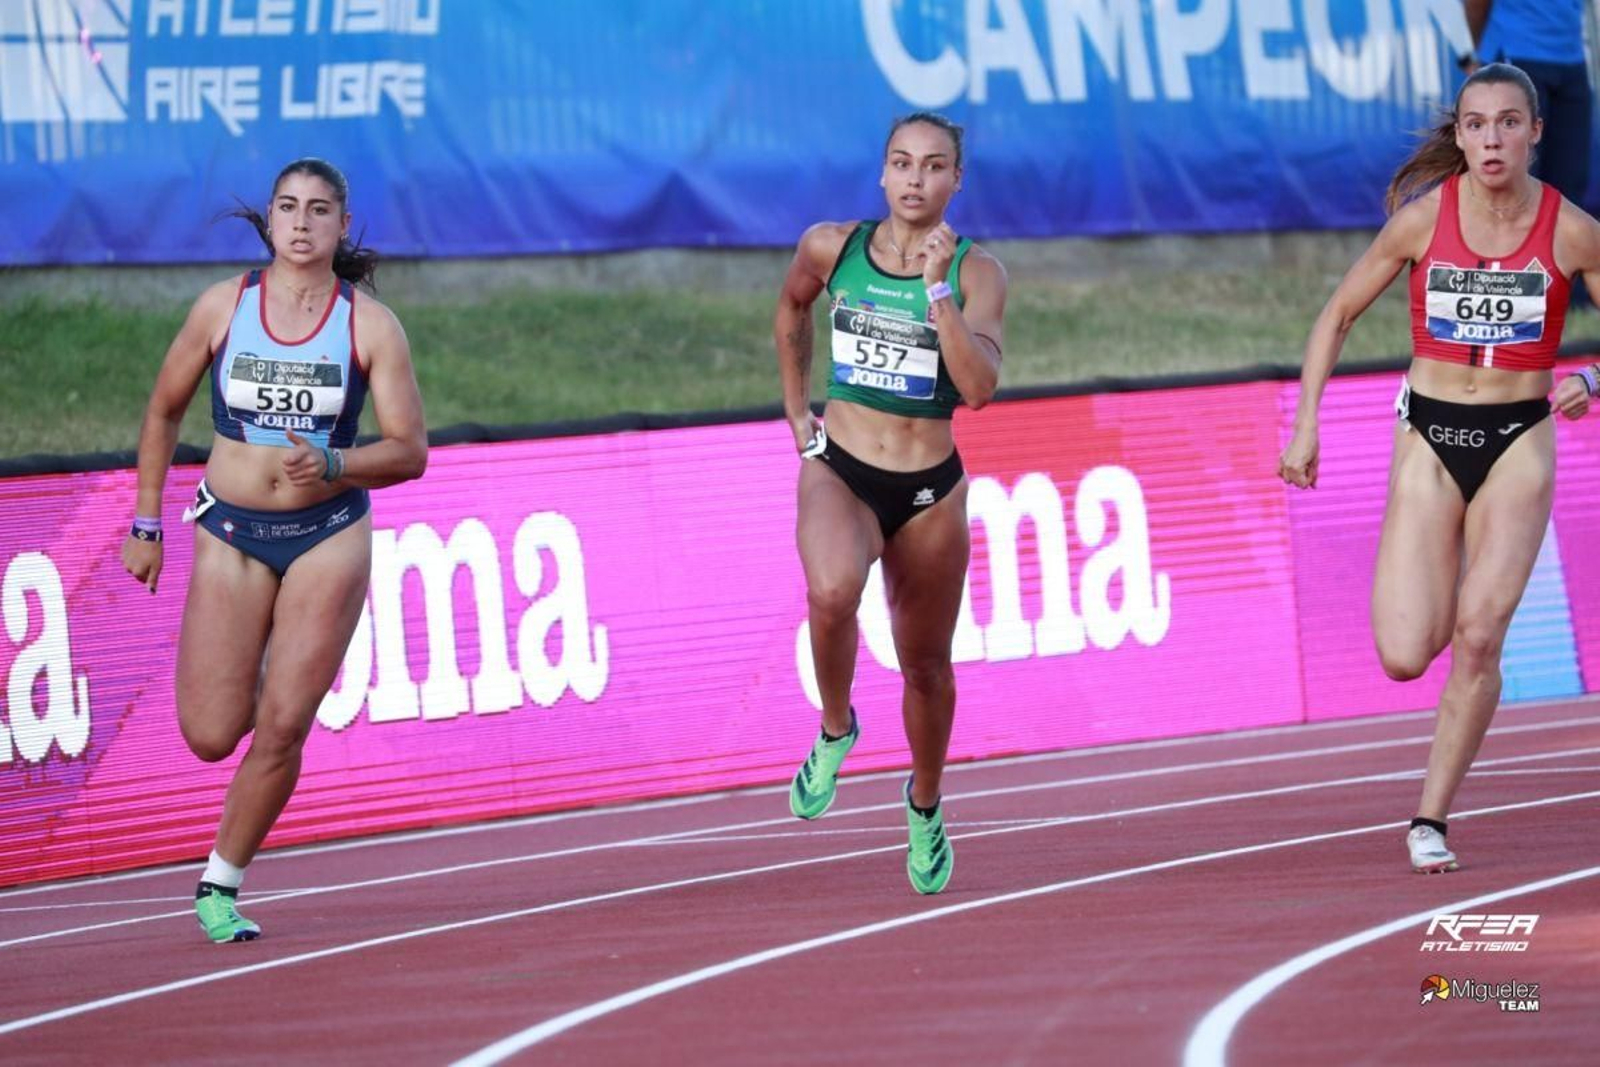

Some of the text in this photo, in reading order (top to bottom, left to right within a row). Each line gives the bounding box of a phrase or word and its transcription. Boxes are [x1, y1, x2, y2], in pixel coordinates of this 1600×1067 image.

[145, 60, 426, 137] AIRE LIBRE
[1473, 272, 1516, 285] Diputació
[1472, 284, 1484, 294] de
[1456, 296, 1514, 322] 649
[872, 317, 913, 334] Diputació
[870, 329, 882, 339] de
[854, 339, 909, 371] 557
[273, 362, 316, 376] Diputació
[272, 375, 285, 384] de
[256, 386, 314, 413] 530
